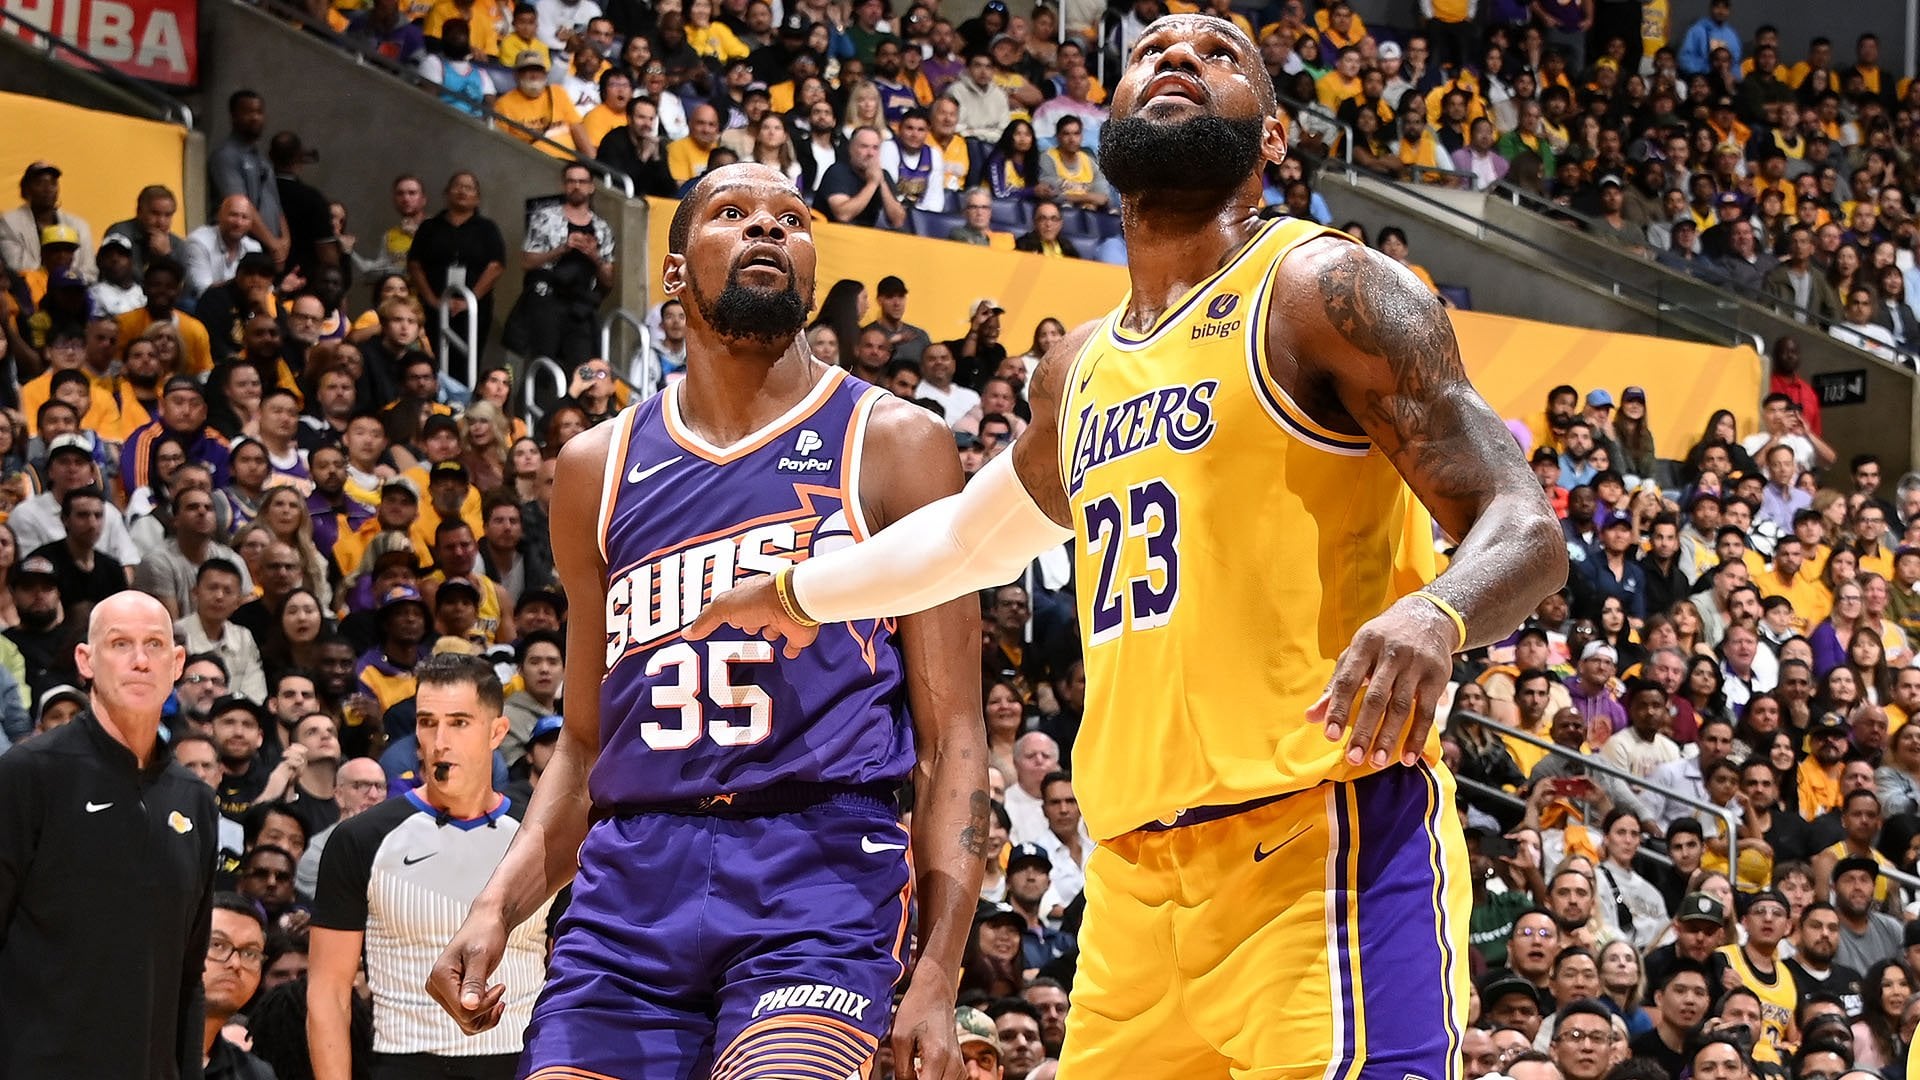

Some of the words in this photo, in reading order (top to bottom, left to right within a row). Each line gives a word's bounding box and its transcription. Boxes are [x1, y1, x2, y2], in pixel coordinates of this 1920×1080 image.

[1191, 320, 1241, 340] bibigo
[777, 457, 833, 472] PayPal
[1069, 379, 1219, 499] LAKERS
[606, 523, 796, 669] SUNS
[1082, 477, 1181, 646] 23
[640, 641, 774, 750] 35
[751, 984, 871, 1020] PHOENIX
